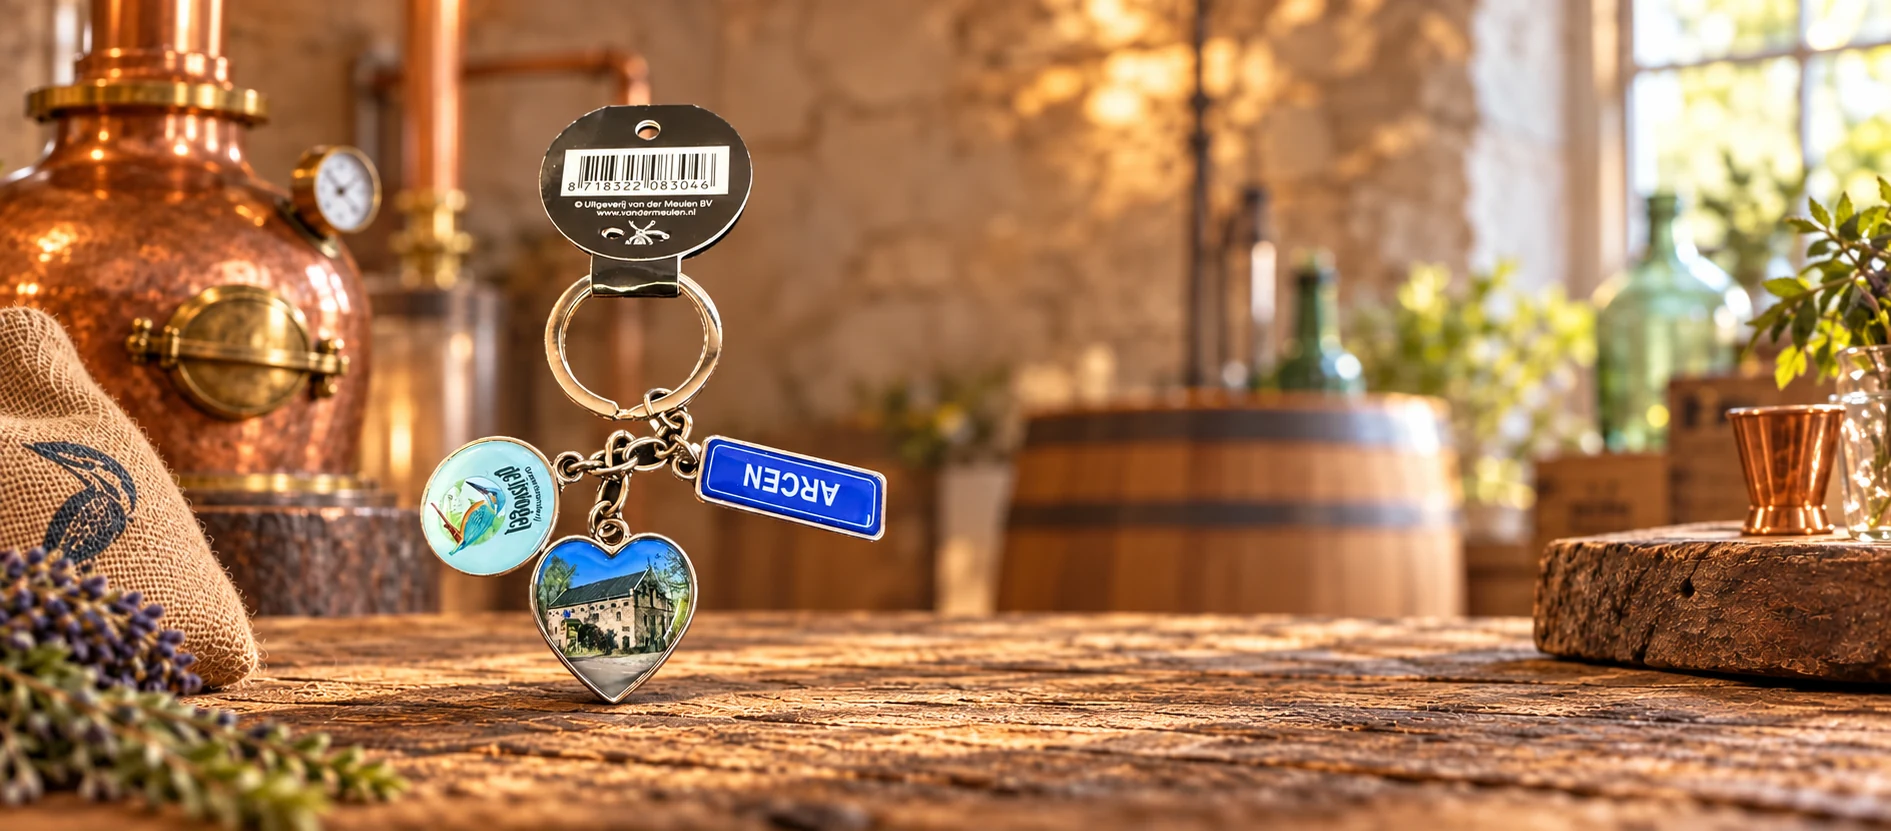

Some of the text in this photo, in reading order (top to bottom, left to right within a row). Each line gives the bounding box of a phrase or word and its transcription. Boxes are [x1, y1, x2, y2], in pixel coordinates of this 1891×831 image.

[568, 180, 709, 192] 8 718322 083046
[584, 200, 627, 209] Uitgeverij
[646, 200, 662, 208] der
[664, 200, 698, 208] Meulen
[699, 200, 713, 208] BV
[596, 209, 696, 217] www.vandermeulen.nl
[743, 463, 841, 507] ARCEN
